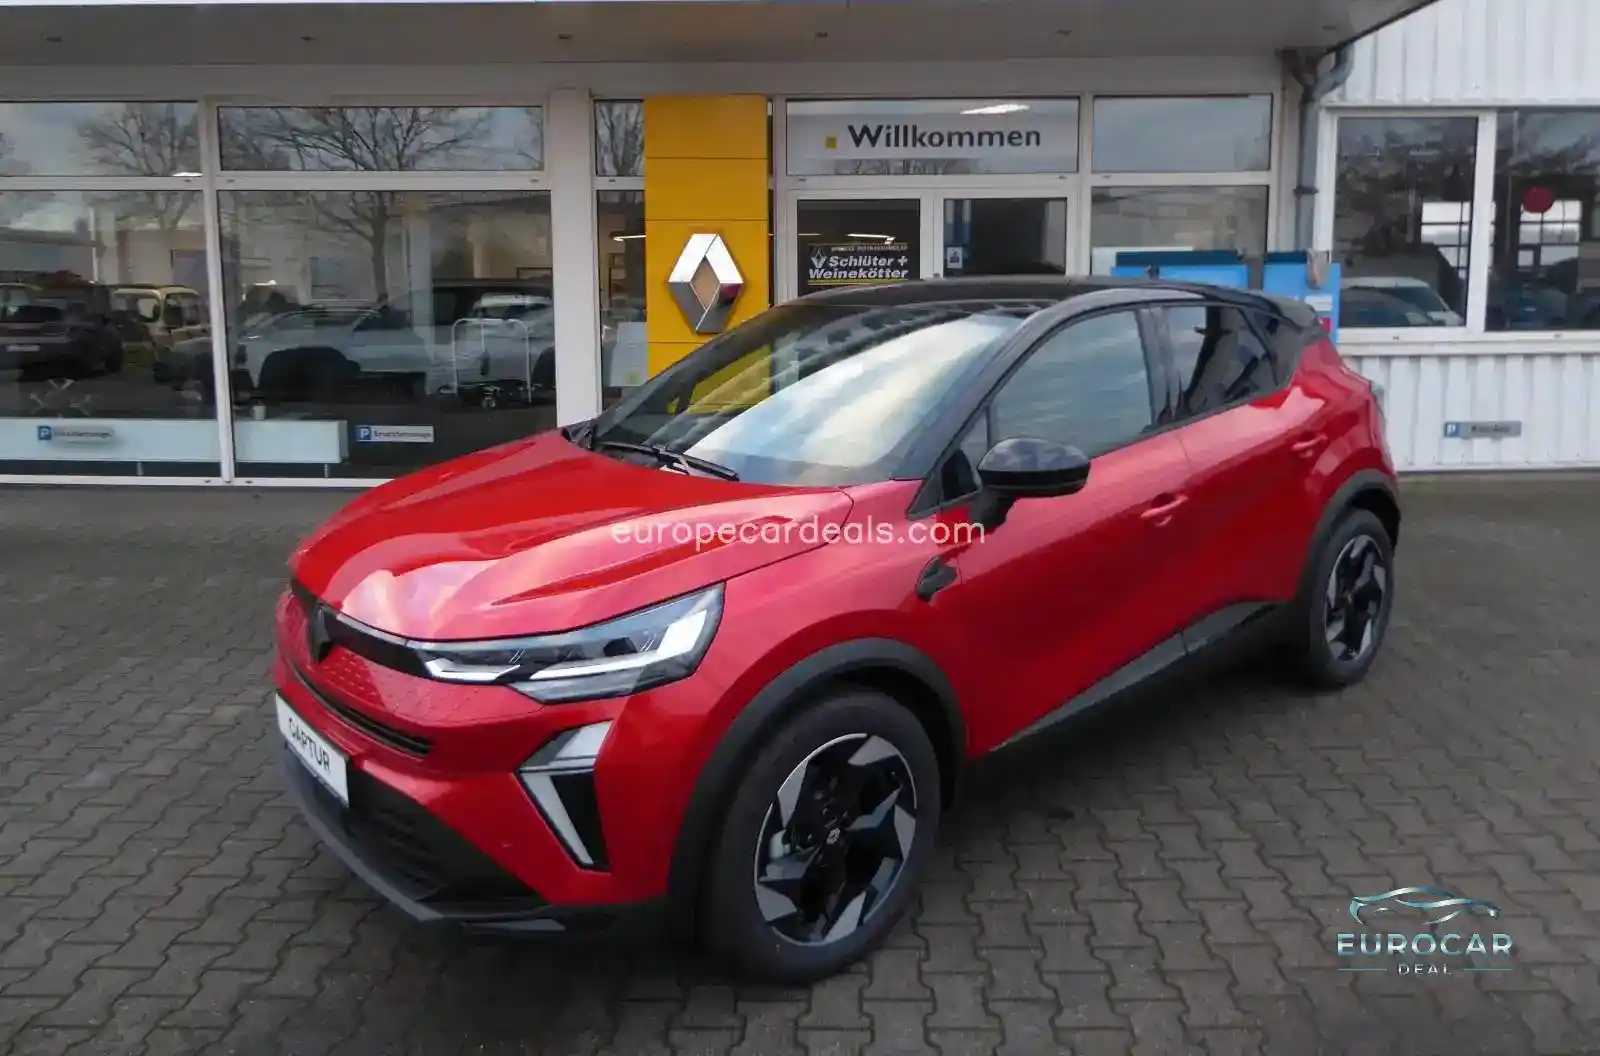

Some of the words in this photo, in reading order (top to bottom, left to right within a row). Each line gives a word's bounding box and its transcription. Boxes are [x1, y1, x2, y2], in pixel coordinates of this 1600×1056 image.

[847, 124, 1041, 148] Willkommen
[828, 255, 894, 268] Schlüter
[897, 256, 908, 267] +
[808, 268, 909, 279] Weinekötter
[360, 427, 370, 440] P
[288, 716, 332, 775] CAPTUR
